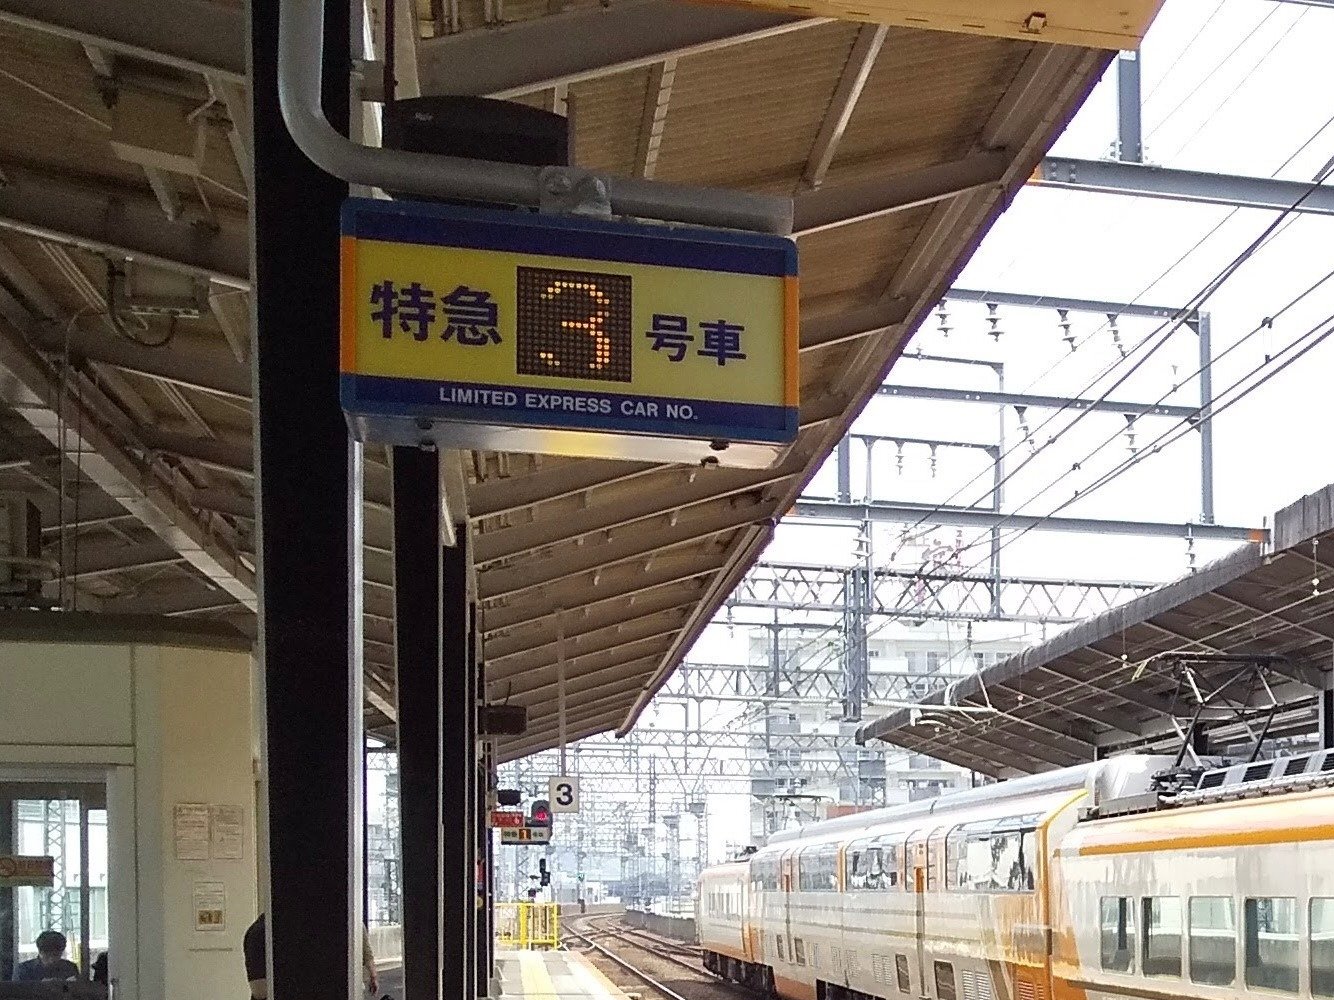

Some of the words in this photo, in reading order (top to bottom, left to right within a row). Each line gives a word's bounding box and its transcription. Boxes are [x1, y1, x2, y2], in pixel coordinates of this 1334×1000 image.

[370, 280, 502, 346] 特急
[540, 281, 610, 369] 3
[645, 313, 746, 366] 号車
[439, 387, 517, 407] LIMITED
[525, 393, 612, 414] EXPRESS
[620, 400, 658, 418] CAR
[666, 404, 699, 420] NO.
[555, 783, 574, 806] 3
